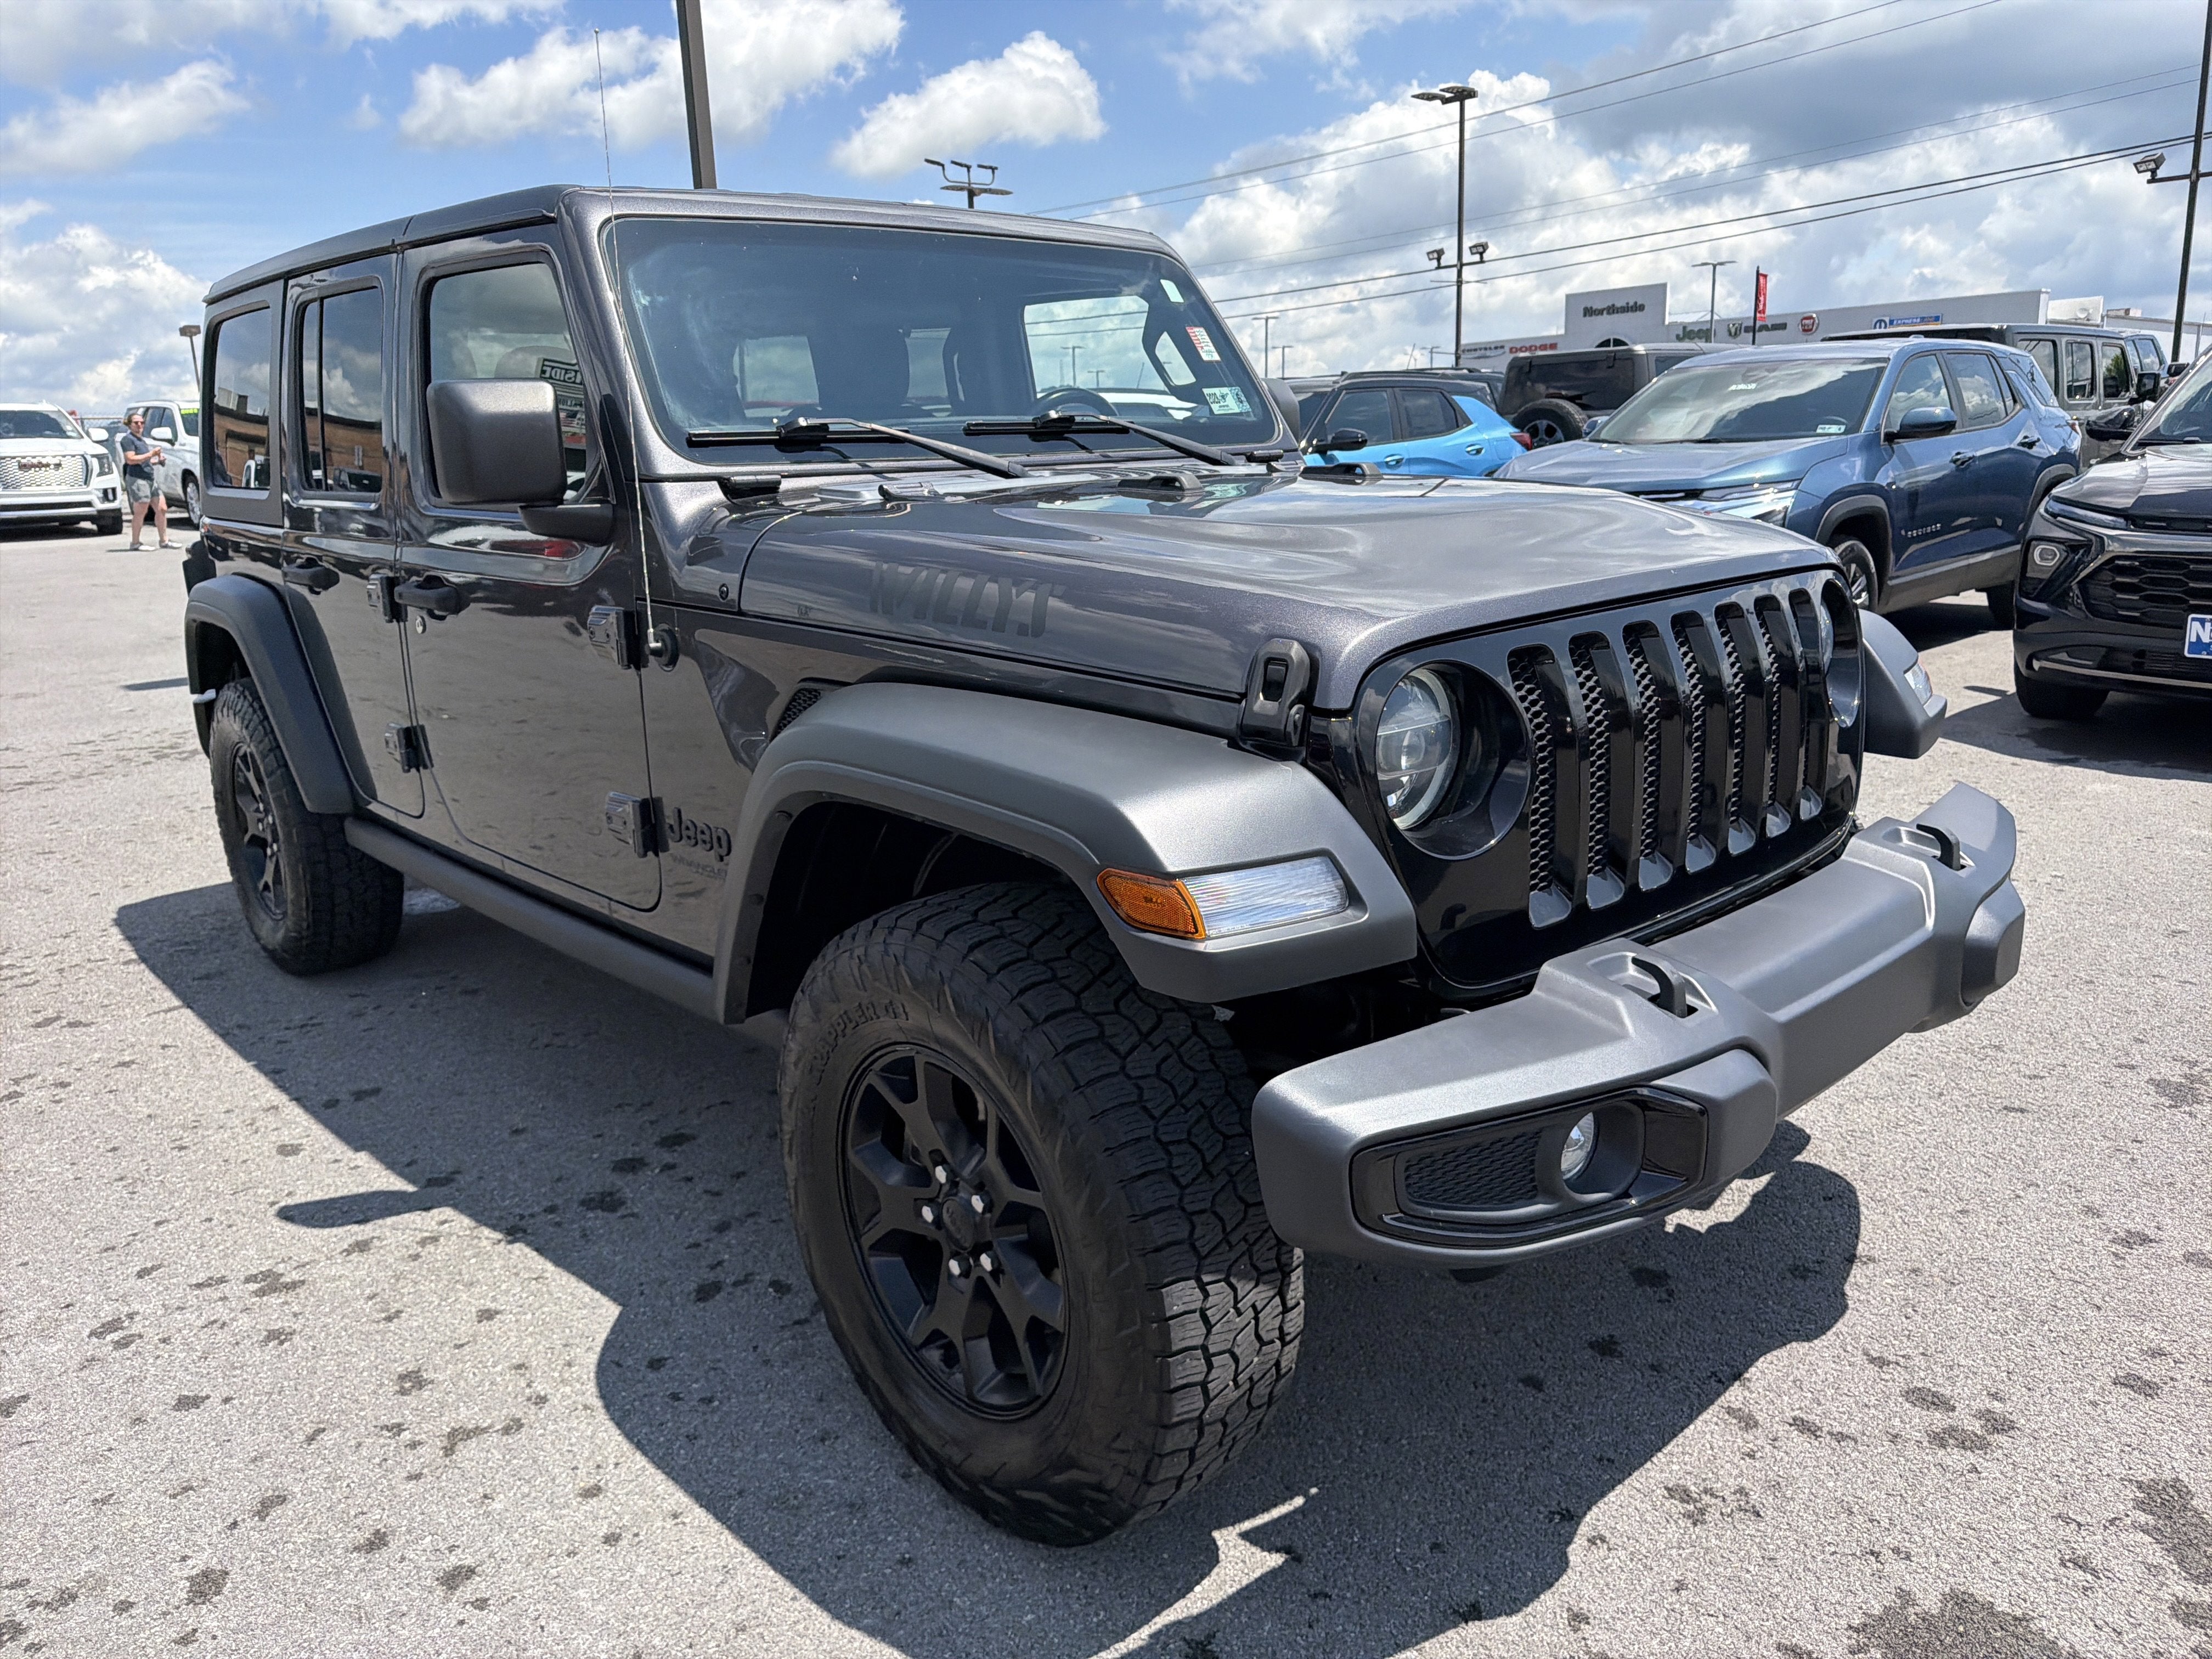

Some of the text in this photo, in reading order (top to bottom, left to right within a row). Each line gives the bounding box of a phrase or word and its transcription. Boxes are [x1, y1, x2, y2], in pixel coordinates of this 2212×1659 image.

[1583, 301, 1645, 318] Northside
[1675, 325, 1716, 343] Jeep
[1509, 343, 1558, 354] DODGE
[667, 807, 732, 862] Jeep
